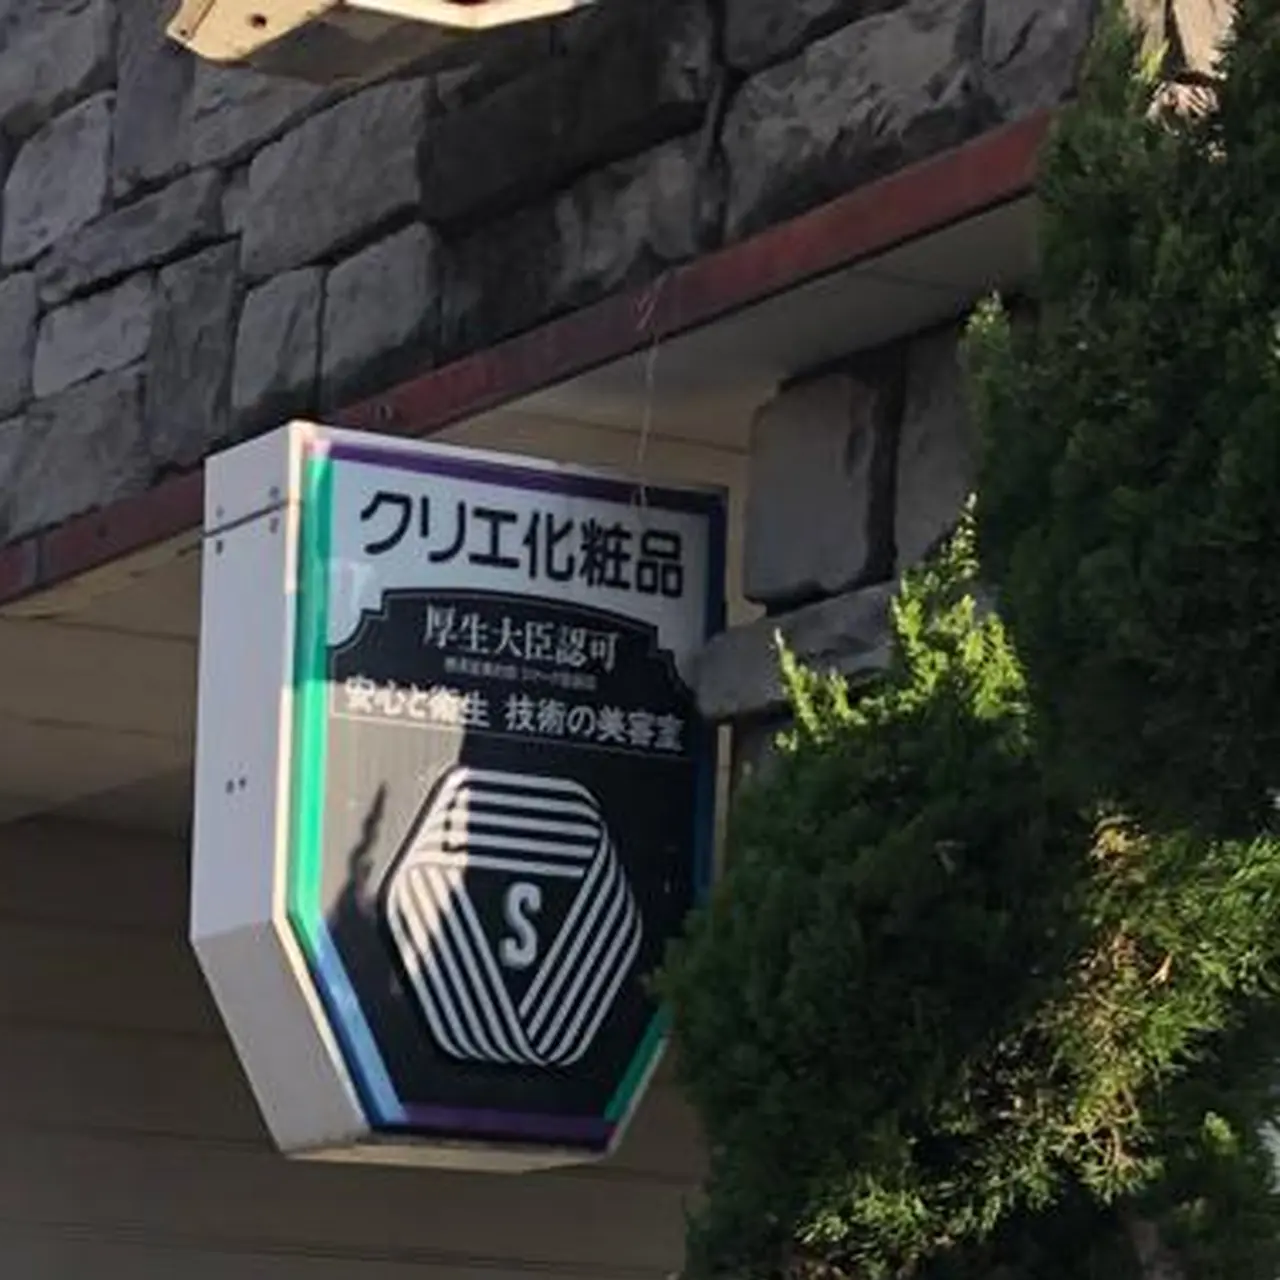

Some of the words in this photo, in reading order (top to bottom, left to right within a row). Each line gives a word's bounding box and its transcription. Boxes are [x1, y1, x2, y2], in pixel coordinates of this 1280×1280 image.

[360, 490, 683, 597] クリエ化粧品
[425, 606, 618, 672] 厚生大臣認可
[501, 882, 541, 968] S
